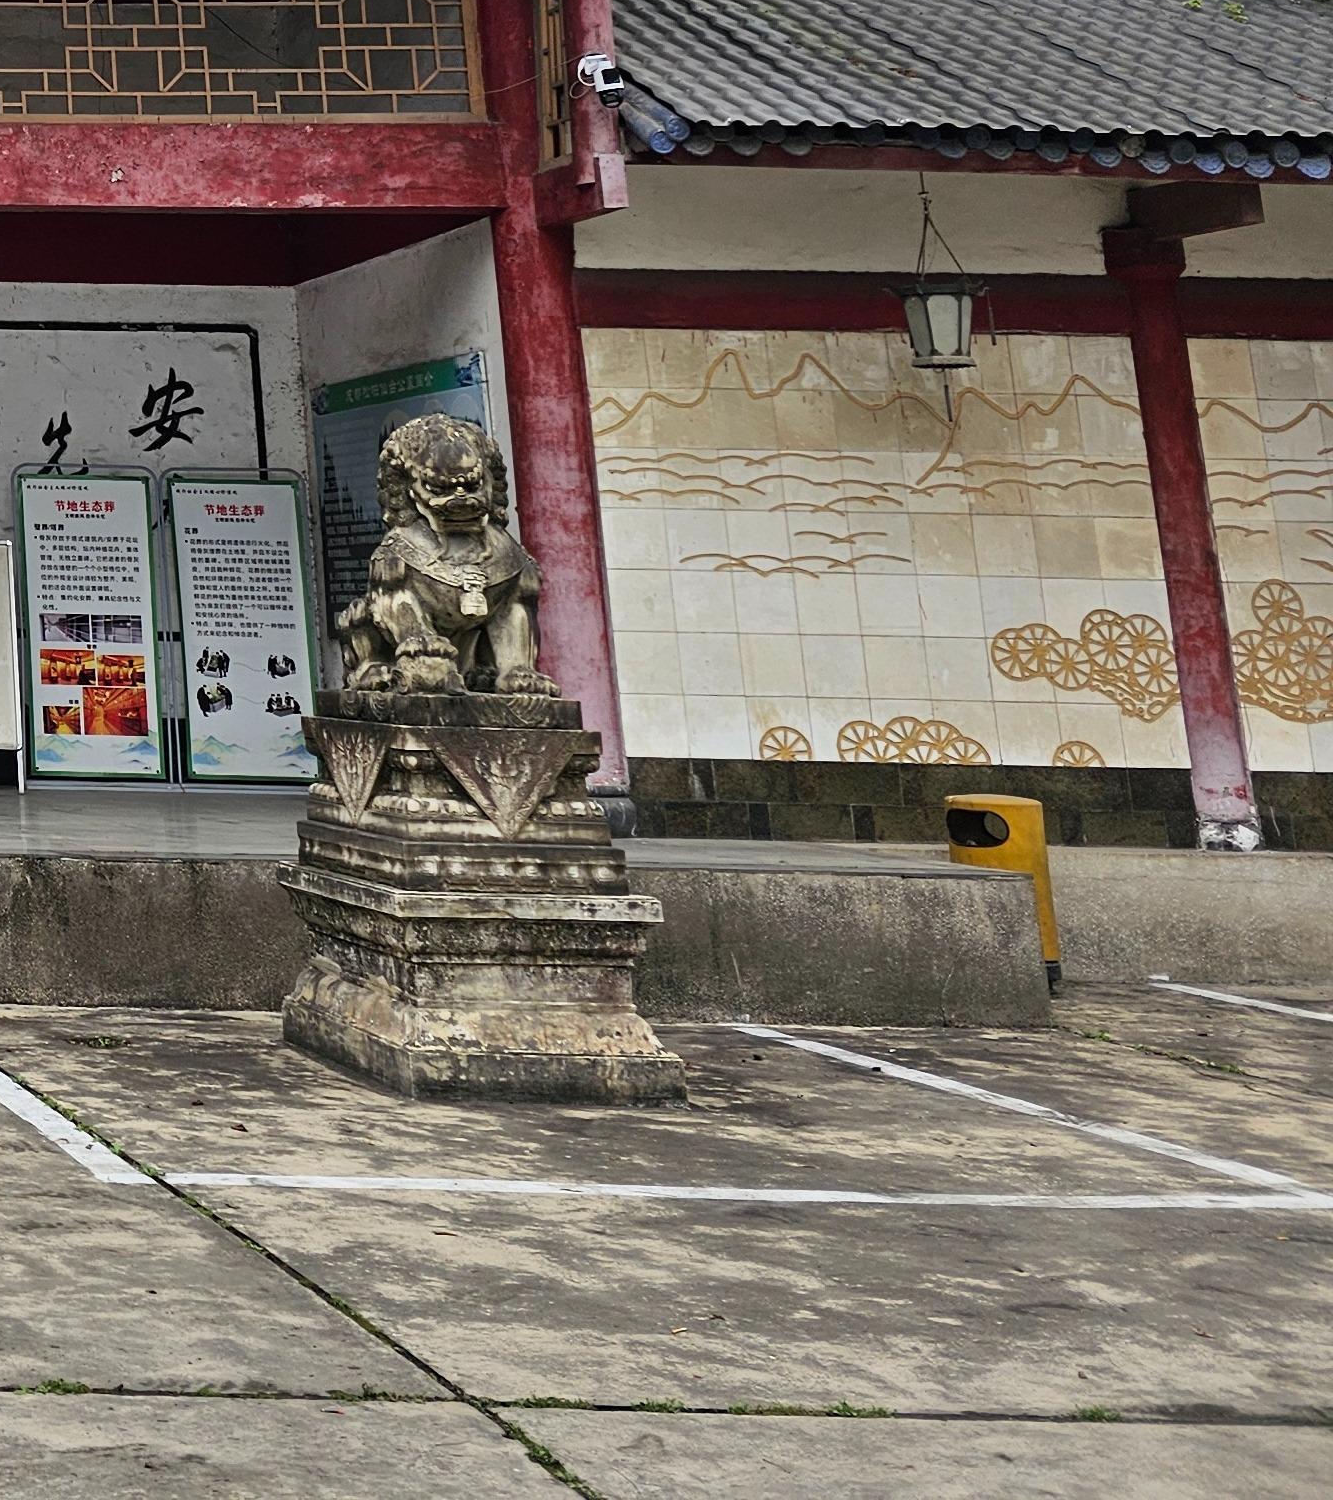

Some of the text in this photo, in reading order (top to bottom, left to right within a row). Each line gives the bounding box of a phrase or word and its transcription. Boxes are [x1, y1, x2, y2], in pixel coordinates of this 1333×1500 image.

[54, 500, 116, 513] 节地生态葬
[203, 504, 265, 517] 节地生态葬
